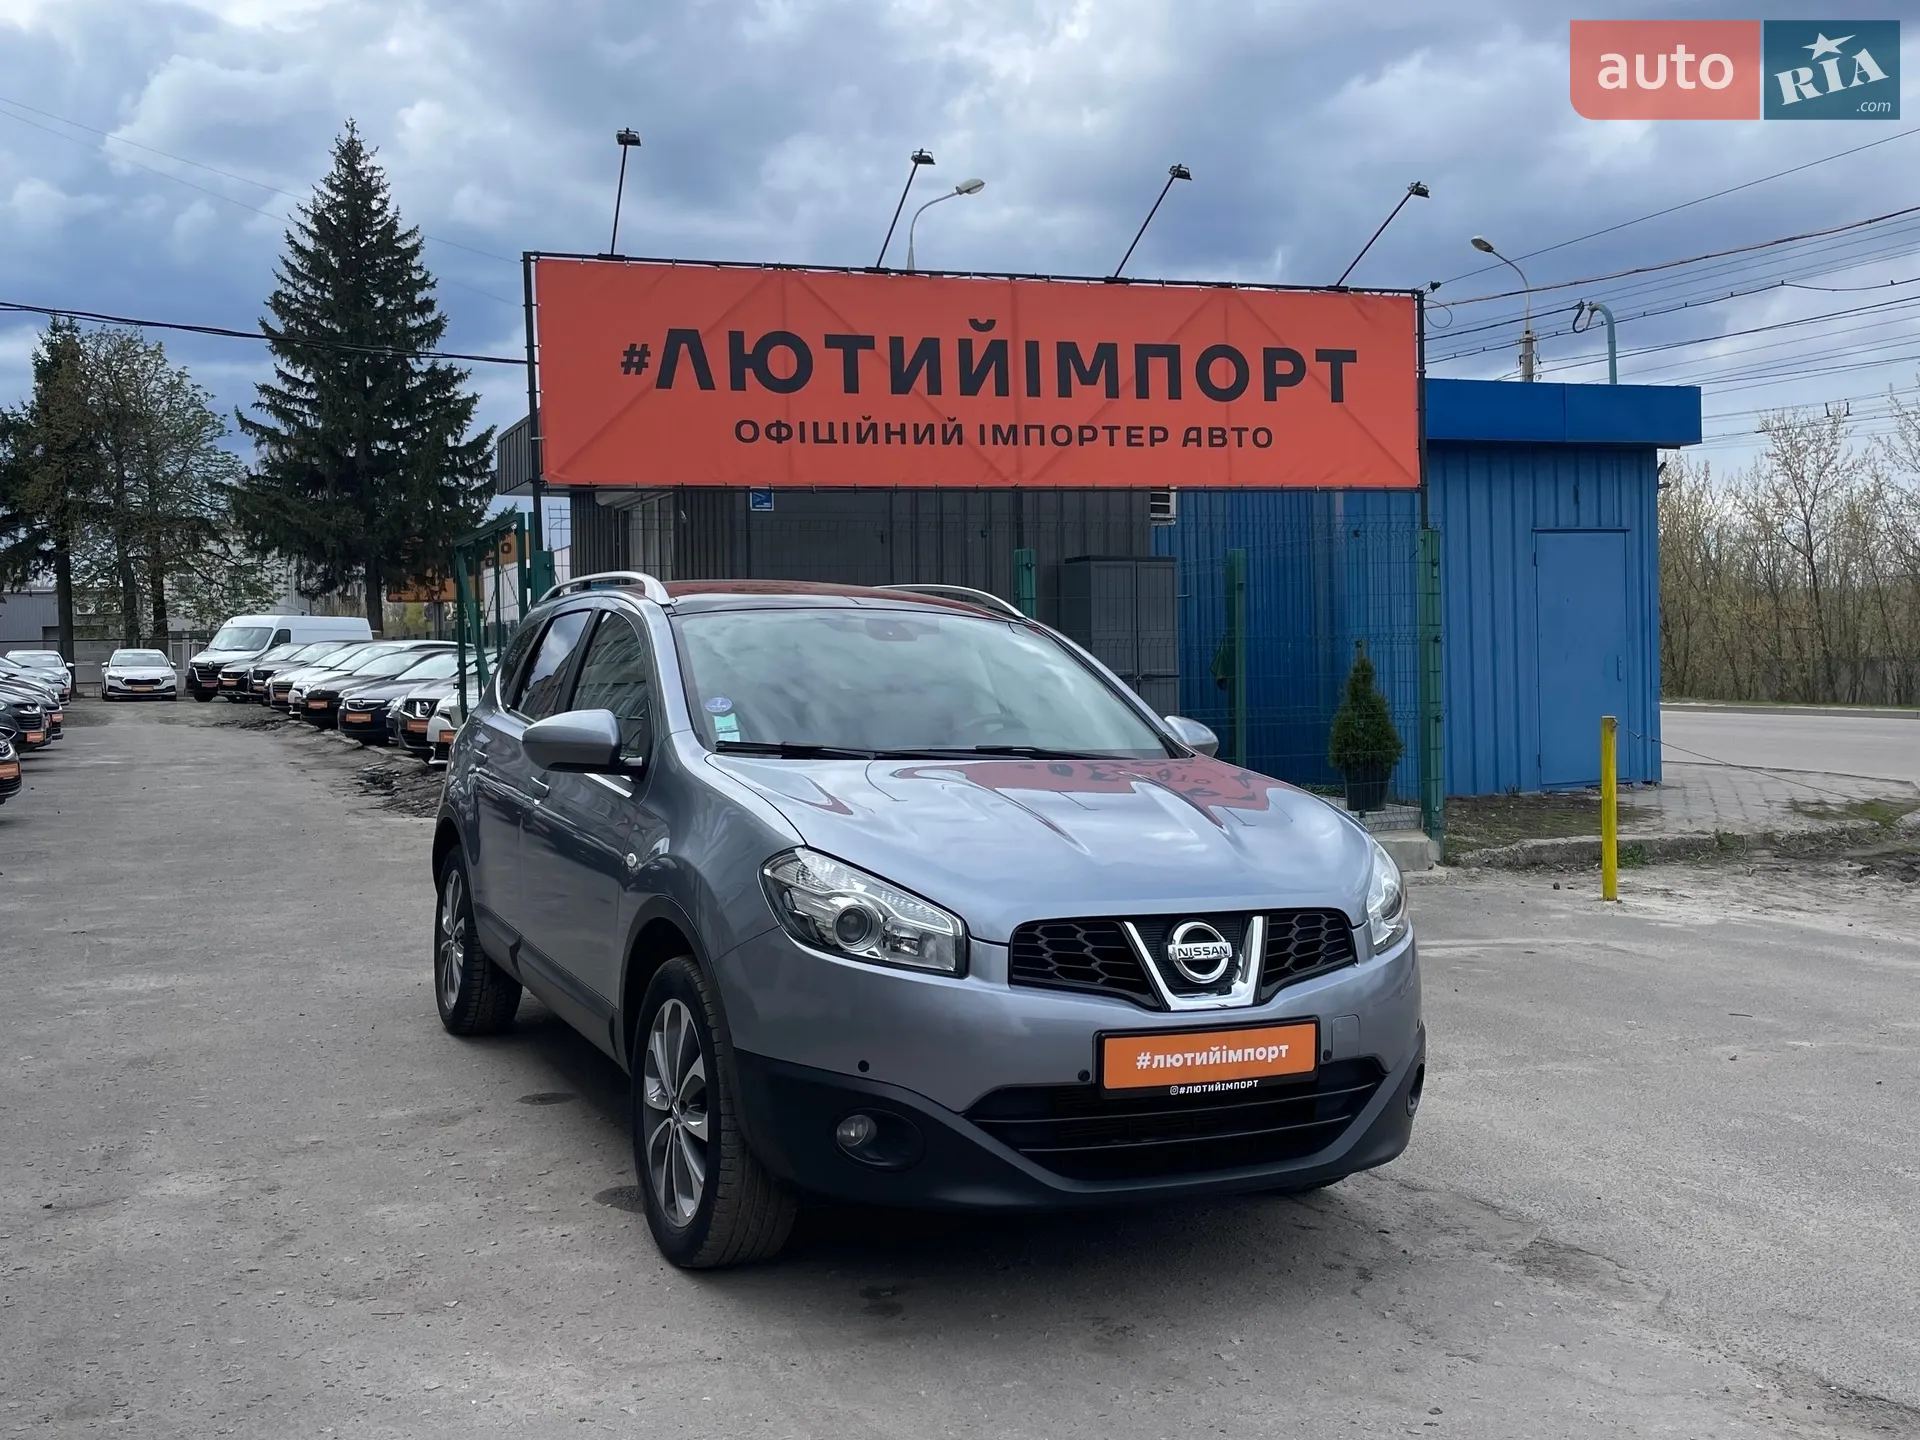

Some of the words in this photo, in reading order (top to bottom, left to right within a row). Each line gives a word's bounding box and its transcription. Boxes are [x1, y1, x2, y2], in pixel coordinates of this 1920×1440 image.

[621, 318, 1357, 403] #ЛЮТИЙІМПОРТ
[735, 415, 963, 446] ОФІЦІЙНИЙ
[980, 424, 1168, 448] ІМПОРТЕР
[1182, 426, 1273, 449] АВТО
[1178, 946, 1228, 957] NISSAN
[1136, 1044, 1289, 1070] #лютийімпорт
